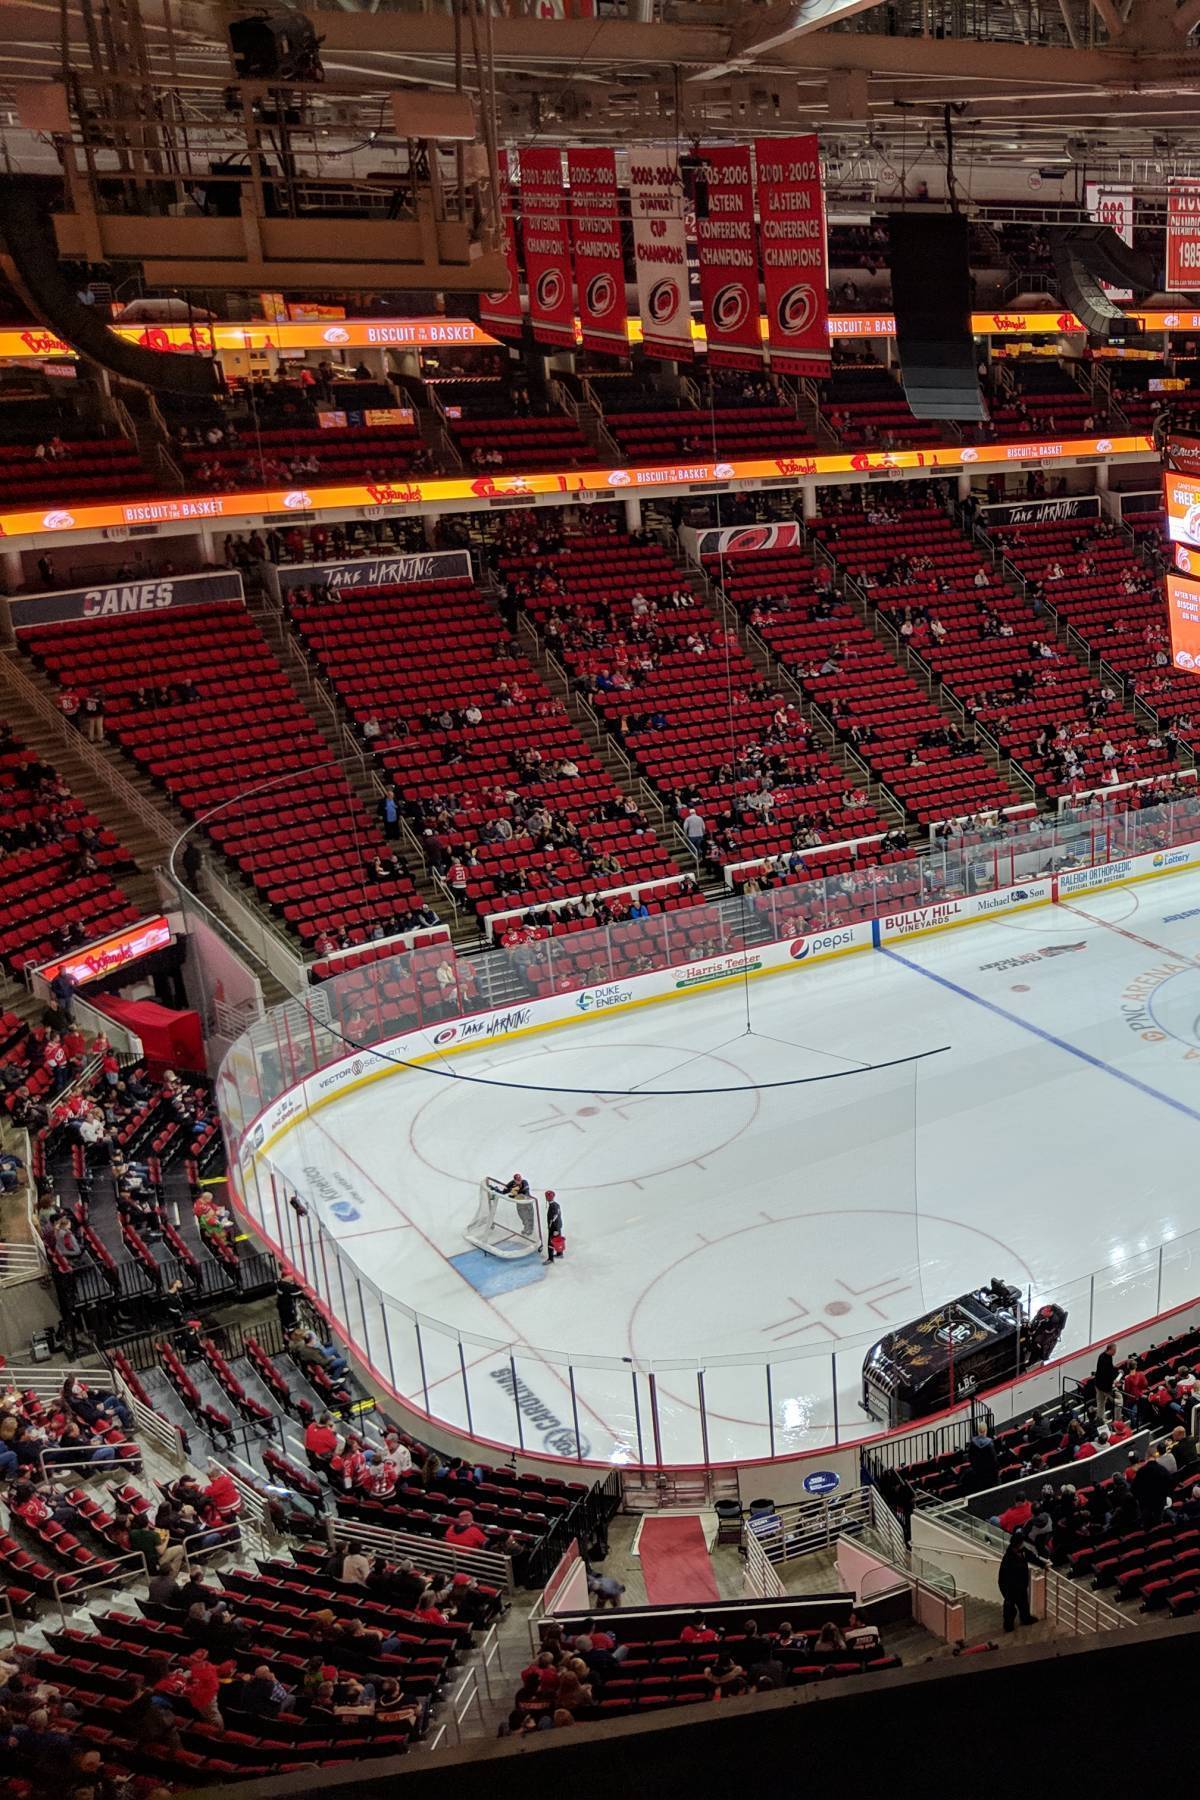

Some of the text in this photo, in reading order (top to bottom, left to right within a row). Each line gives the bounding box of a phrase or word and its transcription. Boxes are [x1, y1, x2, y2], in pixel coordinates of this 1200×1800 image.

[760, 162, 816, 181] 2001-2002
[769, 191, 811, 210] EASTERN
[579, 217, 613, 233] DIVISION
[650, 220, 667, 237] CUP
[700, 221, 751, 240] CONFERENCE
[764, 220, 819, 238] CONFERENCE
[576, 241, 620, 259] CHAMPIONS
[637, 244, 684, 264] CHAMPIONS
[701, 246, 753, 266] CHAMPIONS
[765, 248, 821, 266] CHAMPIONS
[368, 326, 475, 342] BISCUIT BASKET
[828, 320, 862, 333] BISCUIT
[1008, 445, 1063, 458] BISCUIT BASKET
[637, 468, 708, 483] BISCUIT BASKET
[1174, 490, 1195, 506] FREE
[126, 499, 224, 521] BISCUIT BASKET
[1009, 500, 1079, 525] TAKE WARNING
[323, 557, 438, 586] TAKE WARNING
[83, 582, 174, 617] CANES
[1177, 600, 1199, 614] BISCUIT
[1164, 852, 1190, 866] Lottery
[1060, 860, 1132, 888] RALEIGH ORTHOPAEDIC
[1067, 882, 1088, 893] OFFICIAL
[1088, 879, 1103, 889] TEAM
[977, 887, 1046, 912] Michael Son
[885, 902, 962, 930] BULLY HILL
[898, 915, 950, 934] VINEYARDS
[812, 927, 855, 954] pepsi
[686, 963, 723, 979] Harris
[724, 954, 761, 969] Teeter
[594, 984, 620, 998] DUKE
[595, 991, 633, 1009] ENERGY
[1120, 962, 1186, 1033] PNC ARENA
[459, 1006, 532, 1038] TAKE WARNING
[319, 1044, 409, 1089] VECTOR SECURITY
[303, 1165, 342, 1203] Kinetico
[489, 1367, 562, 1432] CAROLINAS
